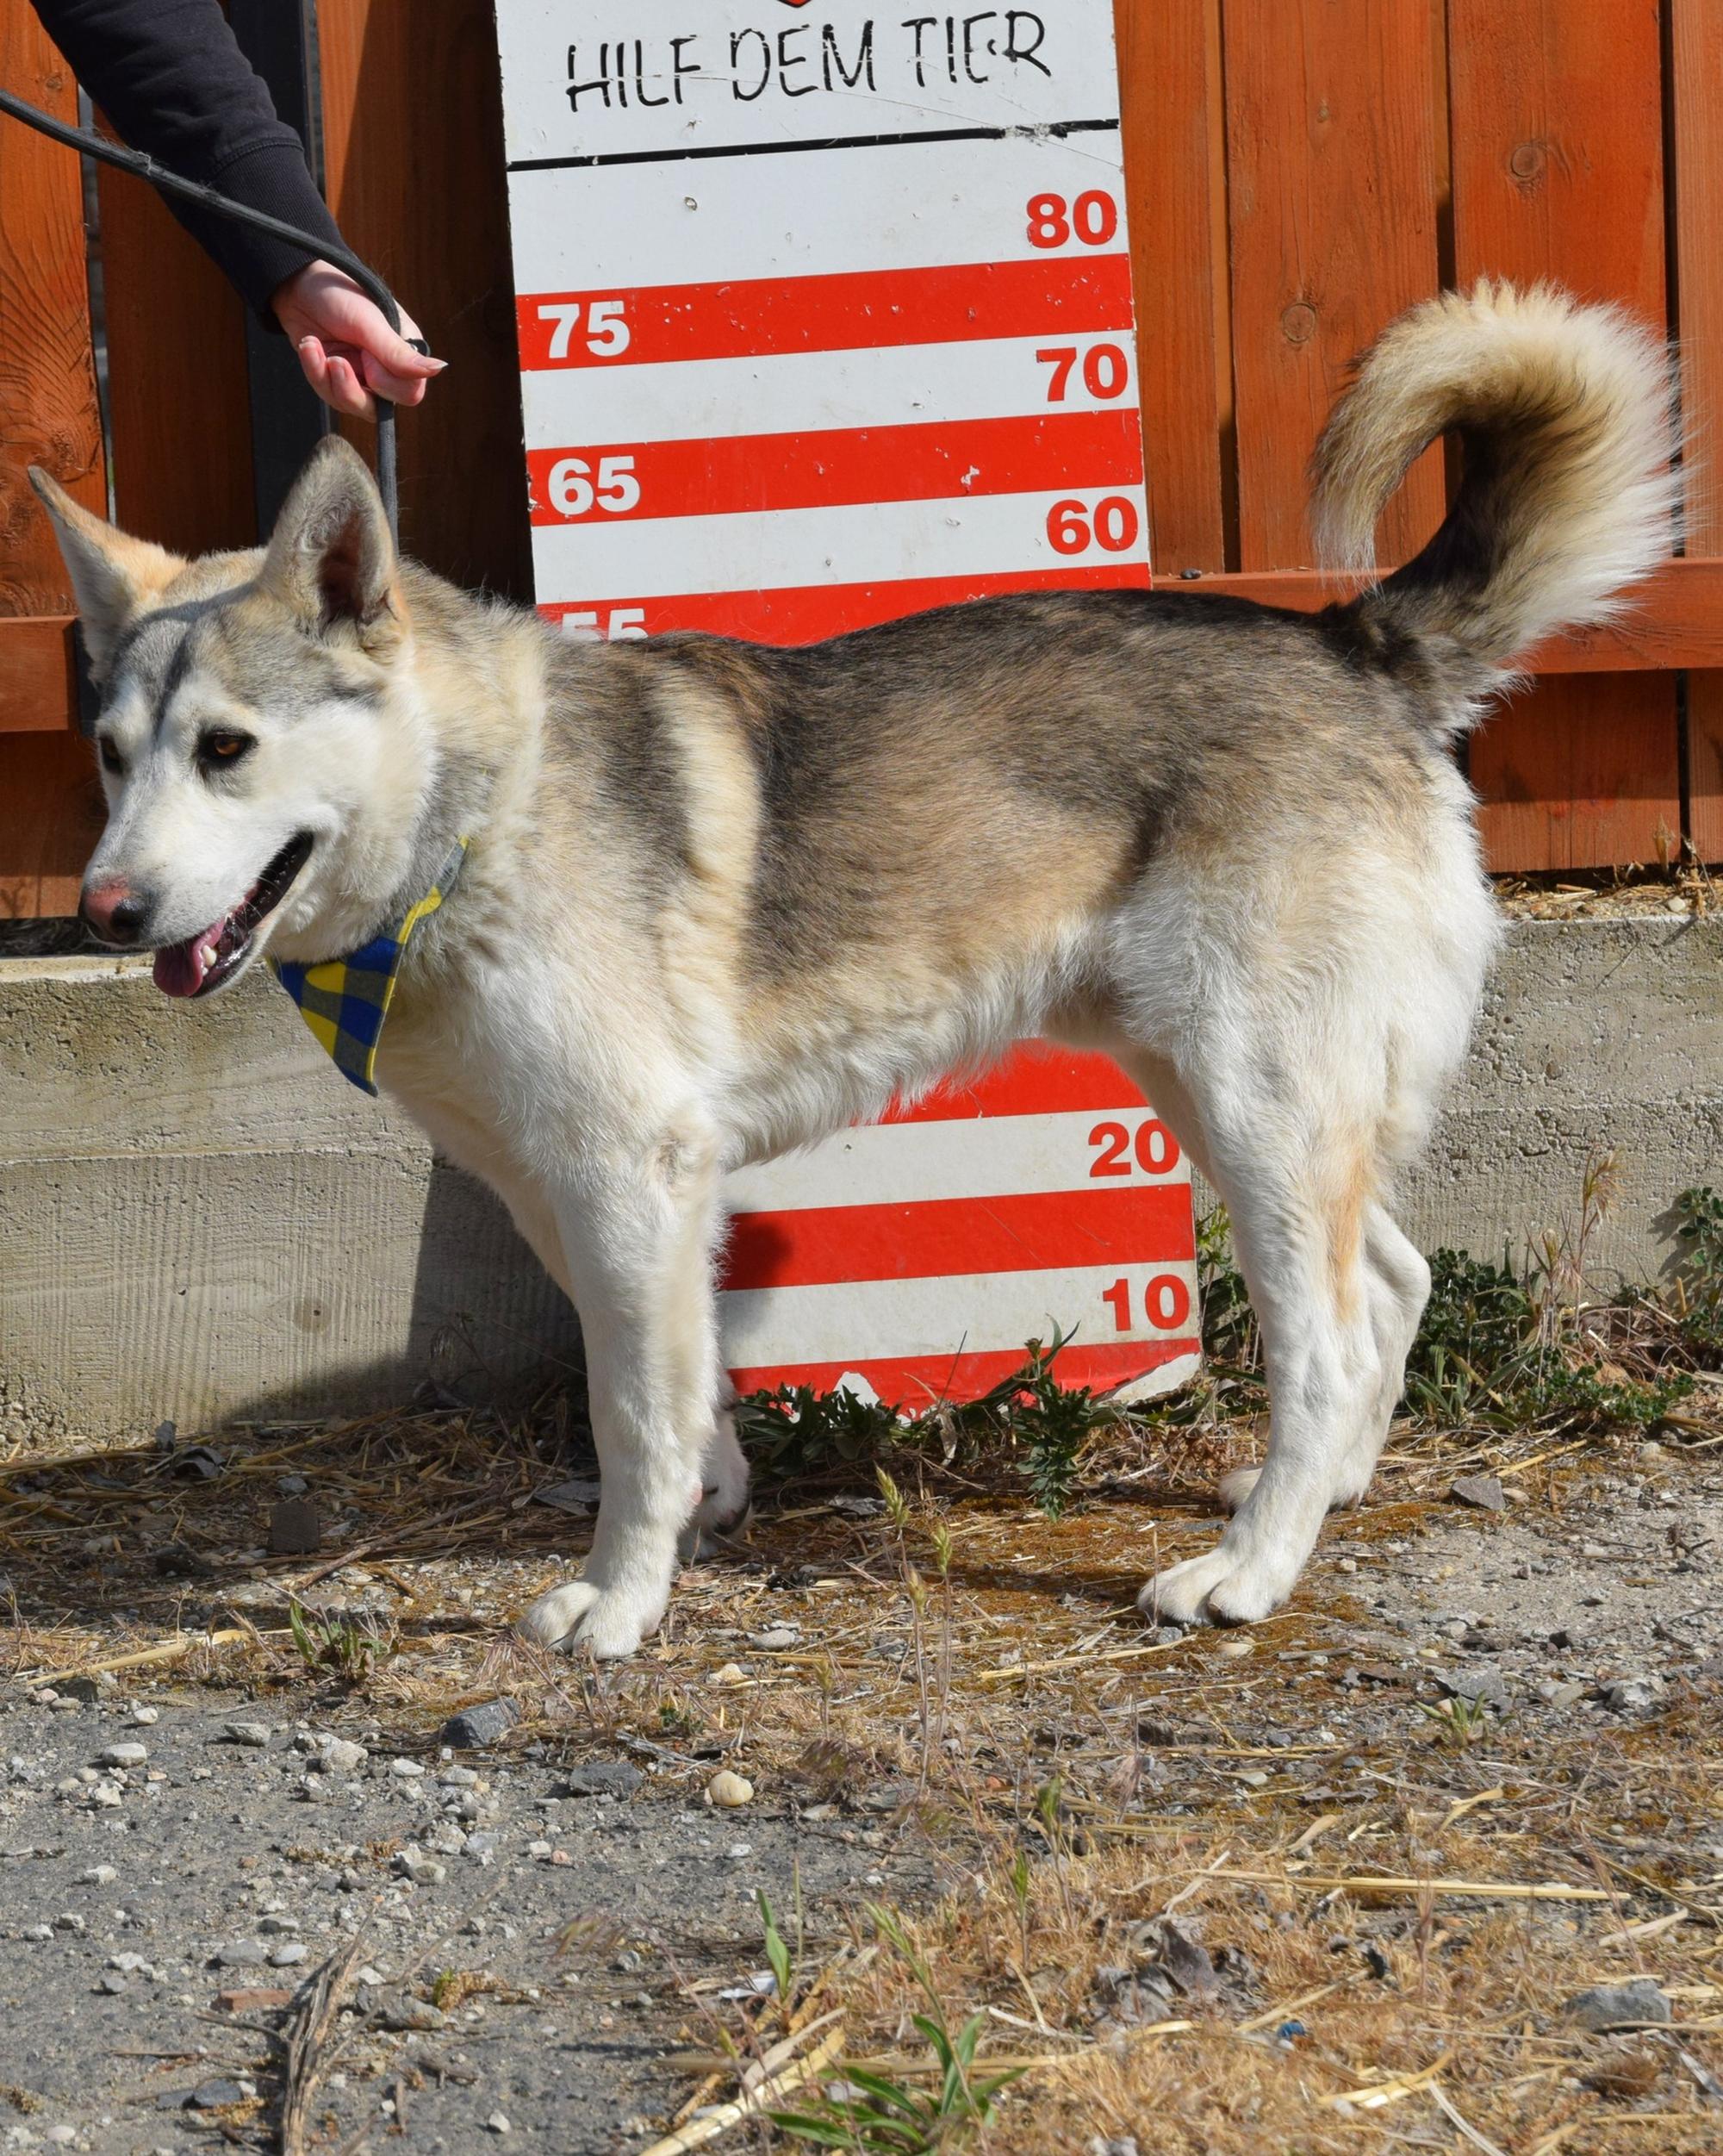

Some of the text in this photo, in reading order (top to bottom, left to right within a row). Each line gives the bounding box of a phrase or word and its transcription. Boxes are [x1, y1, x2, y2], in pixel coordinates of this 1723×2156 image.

[566, 10, 1051, 112] HILF DEM TIER
[1025, 190, 1117, 249] 80
[538, 301, 631, 358] 75
[1036, 343, 1129, 402] 70
[548, 456, 641, 515] 65
[1046, 496, 1138, 555] 60
[1087, 1119, 1179, 1177] 20
[1103, 1274, 1189, 1331] 10
